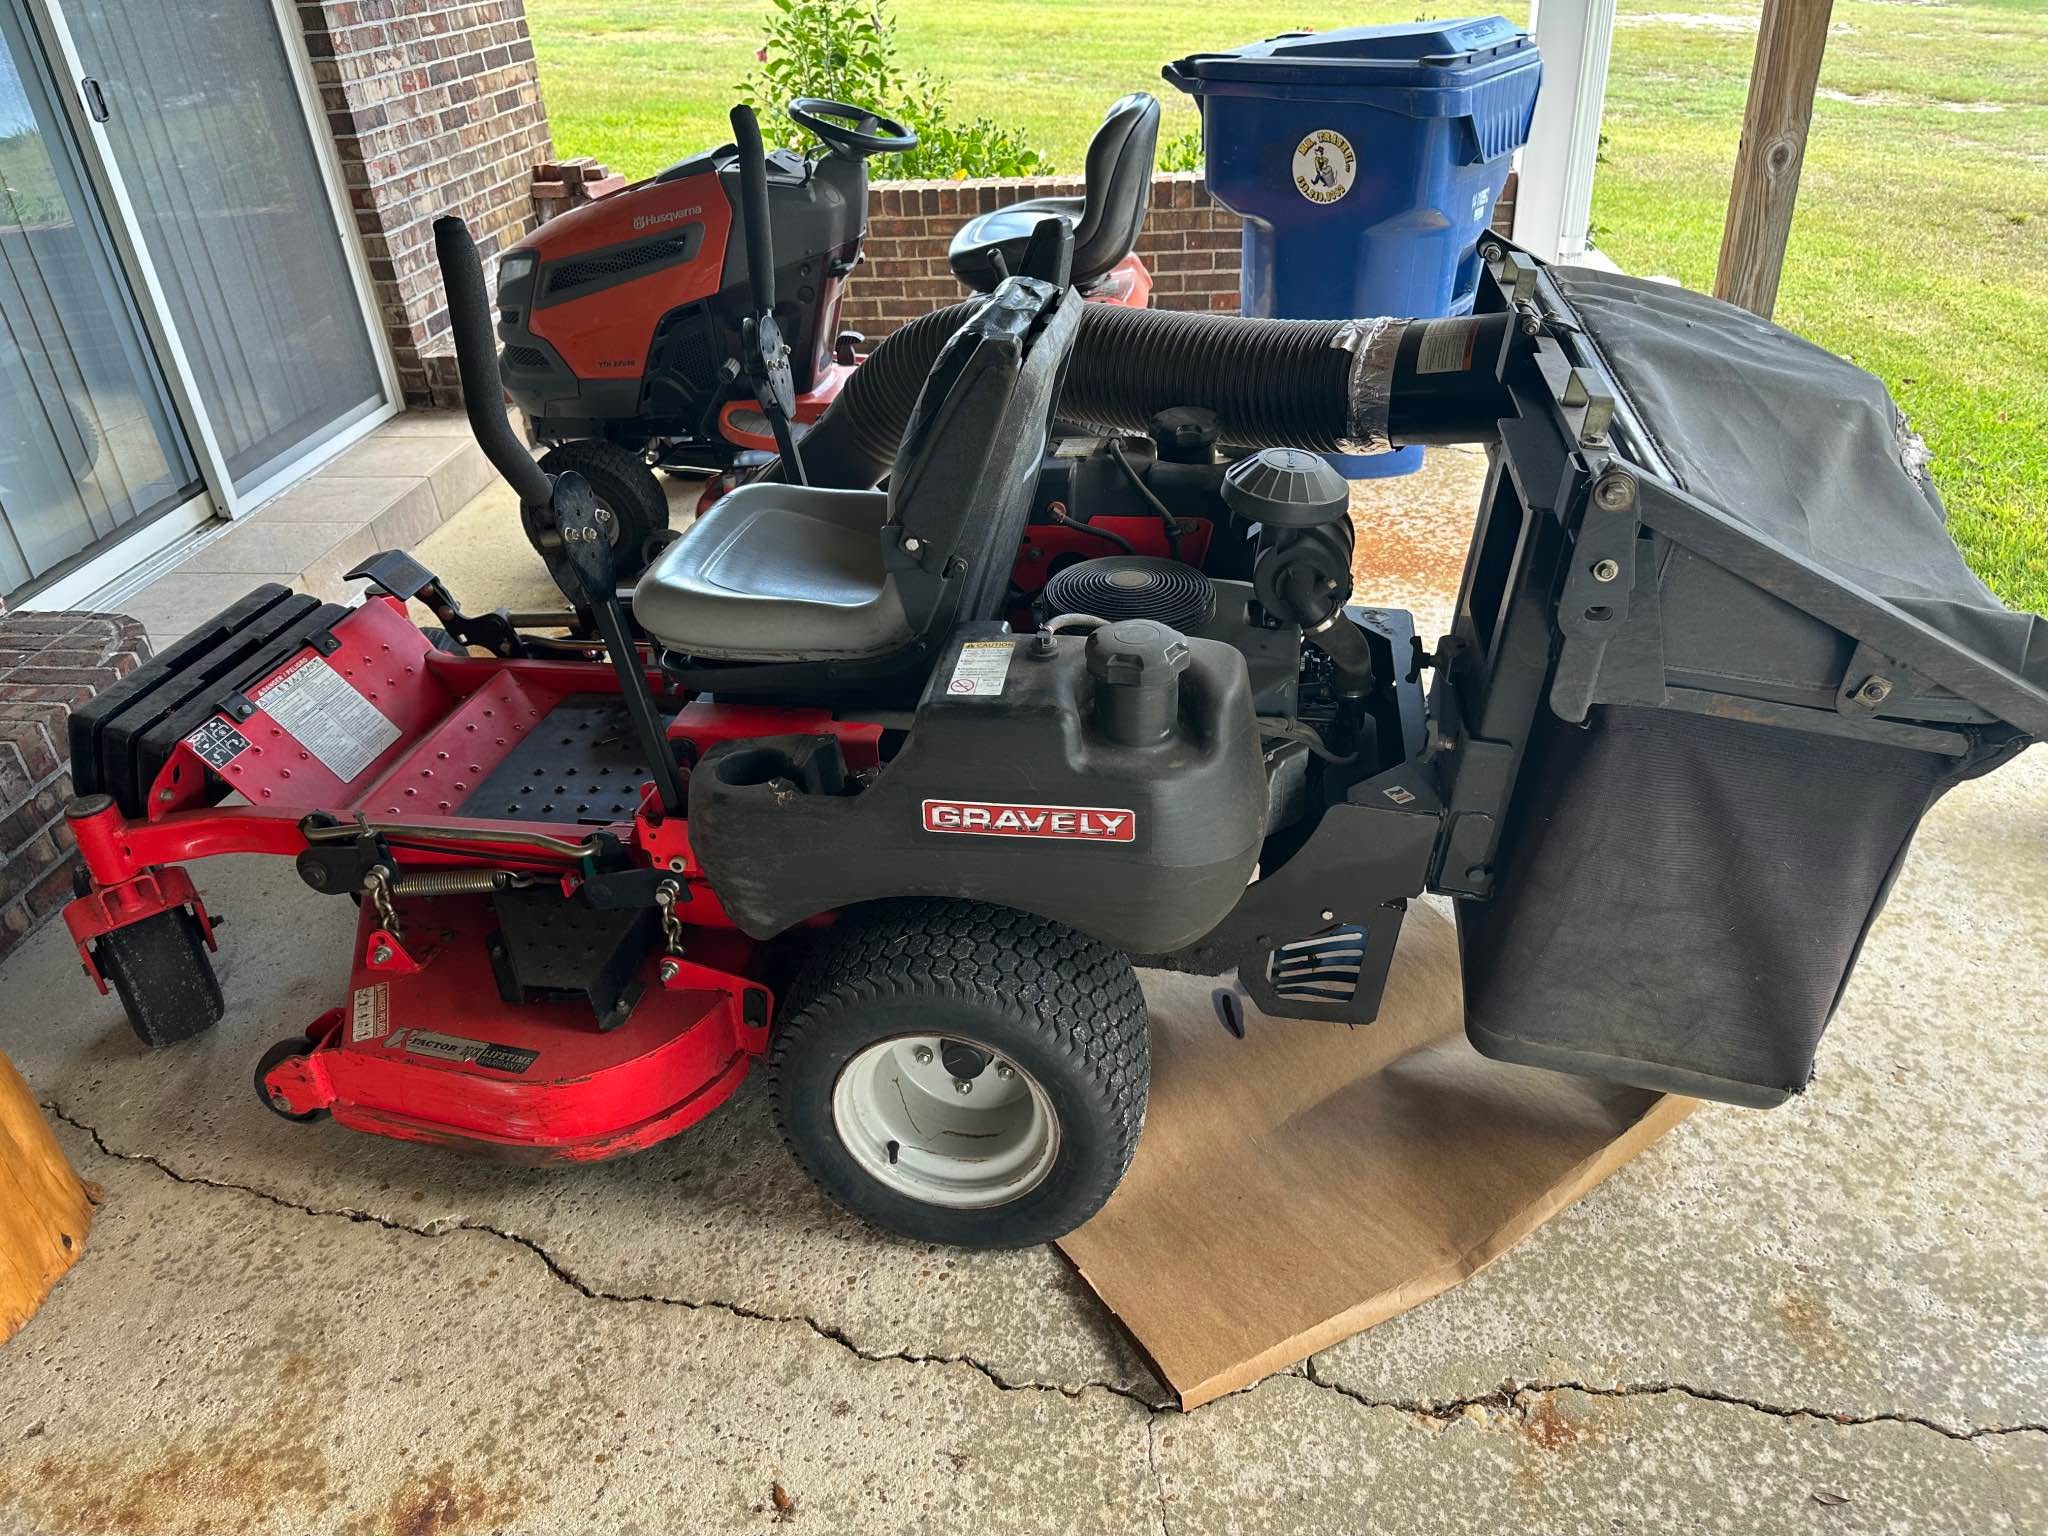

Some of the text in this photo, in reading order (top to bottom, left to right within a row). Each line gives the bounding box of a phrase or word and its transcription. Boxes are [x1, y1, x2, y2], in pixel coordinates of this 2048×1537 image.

[1298, 138, 1317, 156] MR.
[645, 206, 702, 226] Husqvarna
[260, 675, 285, 693] DANGER
[286, 657, 308, 676] PELIGRO
[931, 806, 1128, 836] GRAVELY
[482, 1049, 534, 1065] LIFETIME
